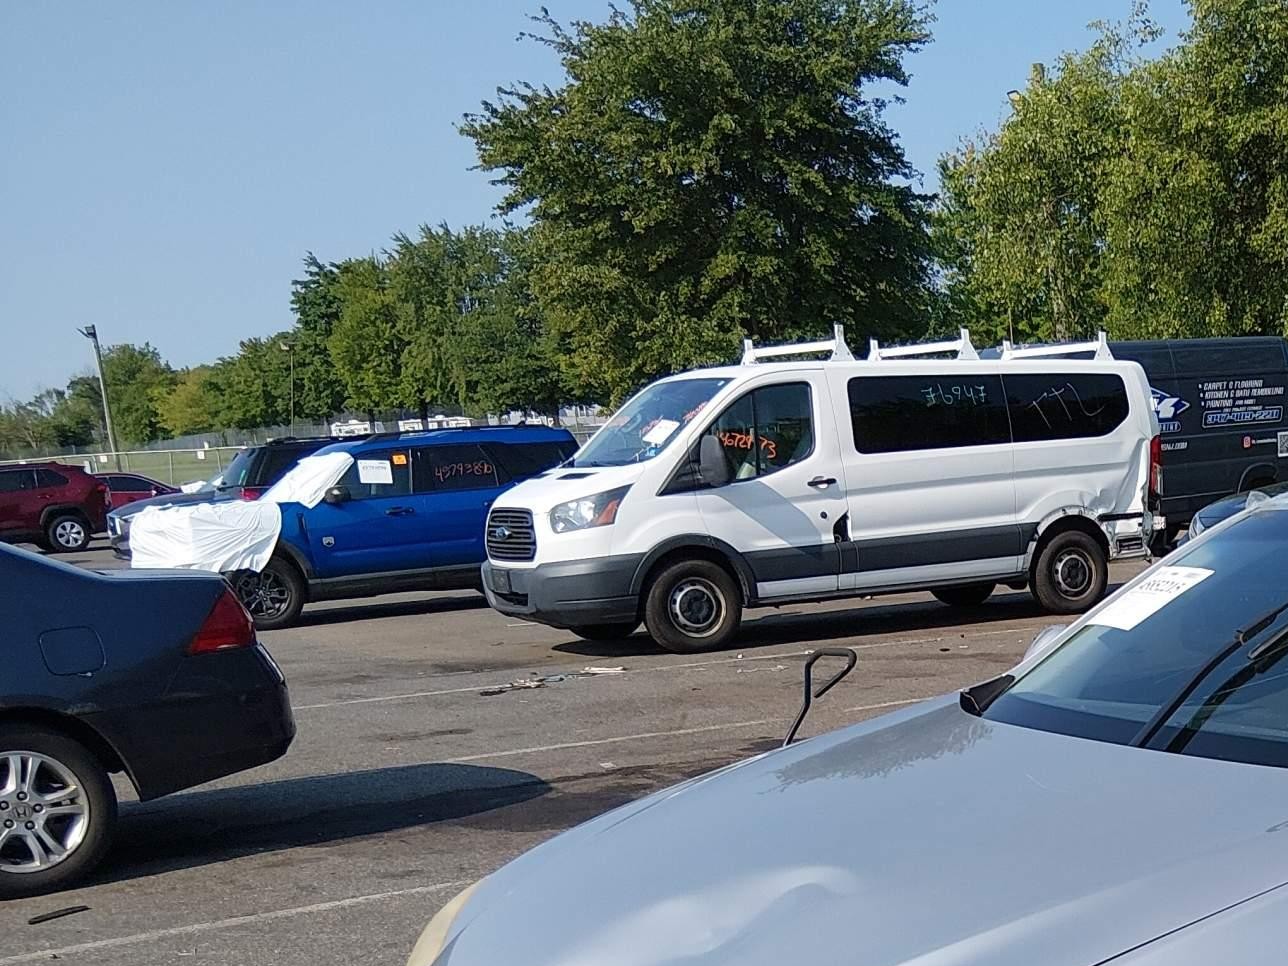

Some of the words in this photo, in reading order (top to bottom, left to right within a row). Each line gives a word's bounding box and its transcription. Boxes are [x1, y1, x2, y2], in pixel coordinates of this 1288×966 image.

[1203, 381, 1227, 391] CARPET
[1204, 390, 1229, 399] KITCHEN
[1205, 399, 1233, 408] PAINTING
